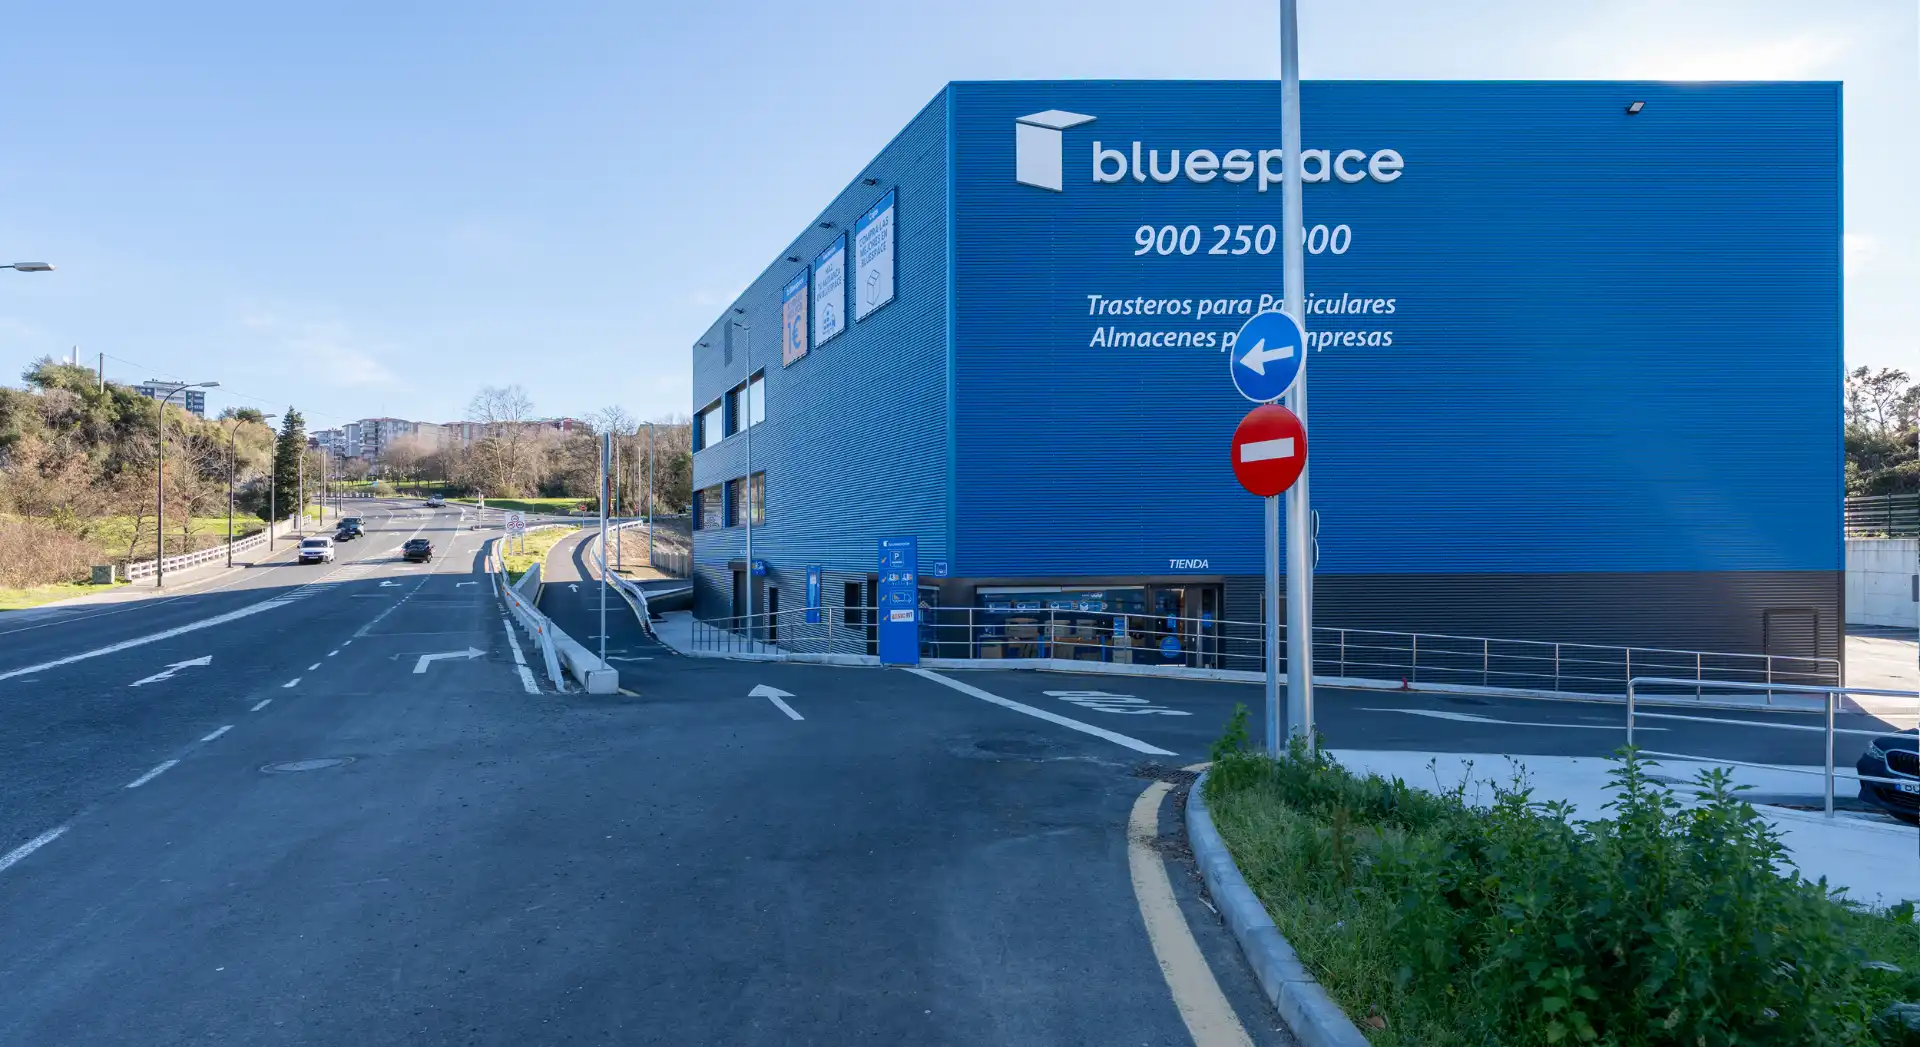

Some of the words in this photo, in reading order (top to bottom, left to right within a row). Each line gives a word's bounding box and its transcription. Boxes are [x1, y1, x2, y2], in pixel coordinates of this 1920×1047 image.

[1092, 141, 1404, 192] bluespace
[1134, 225, 1201, 256] 900
[1208, 224, 1277, 255] 250
[1302, 224, 1351, 255] 00
[1087, 295, 1192, 316] Trasteros
[1197, 299, 1252, 320] para
[1258, 293, 1396, 316] Paiculares
[1090, 326, 1216, 348] Almacenes
[1169, 559, 1209, 569] TIENDA
